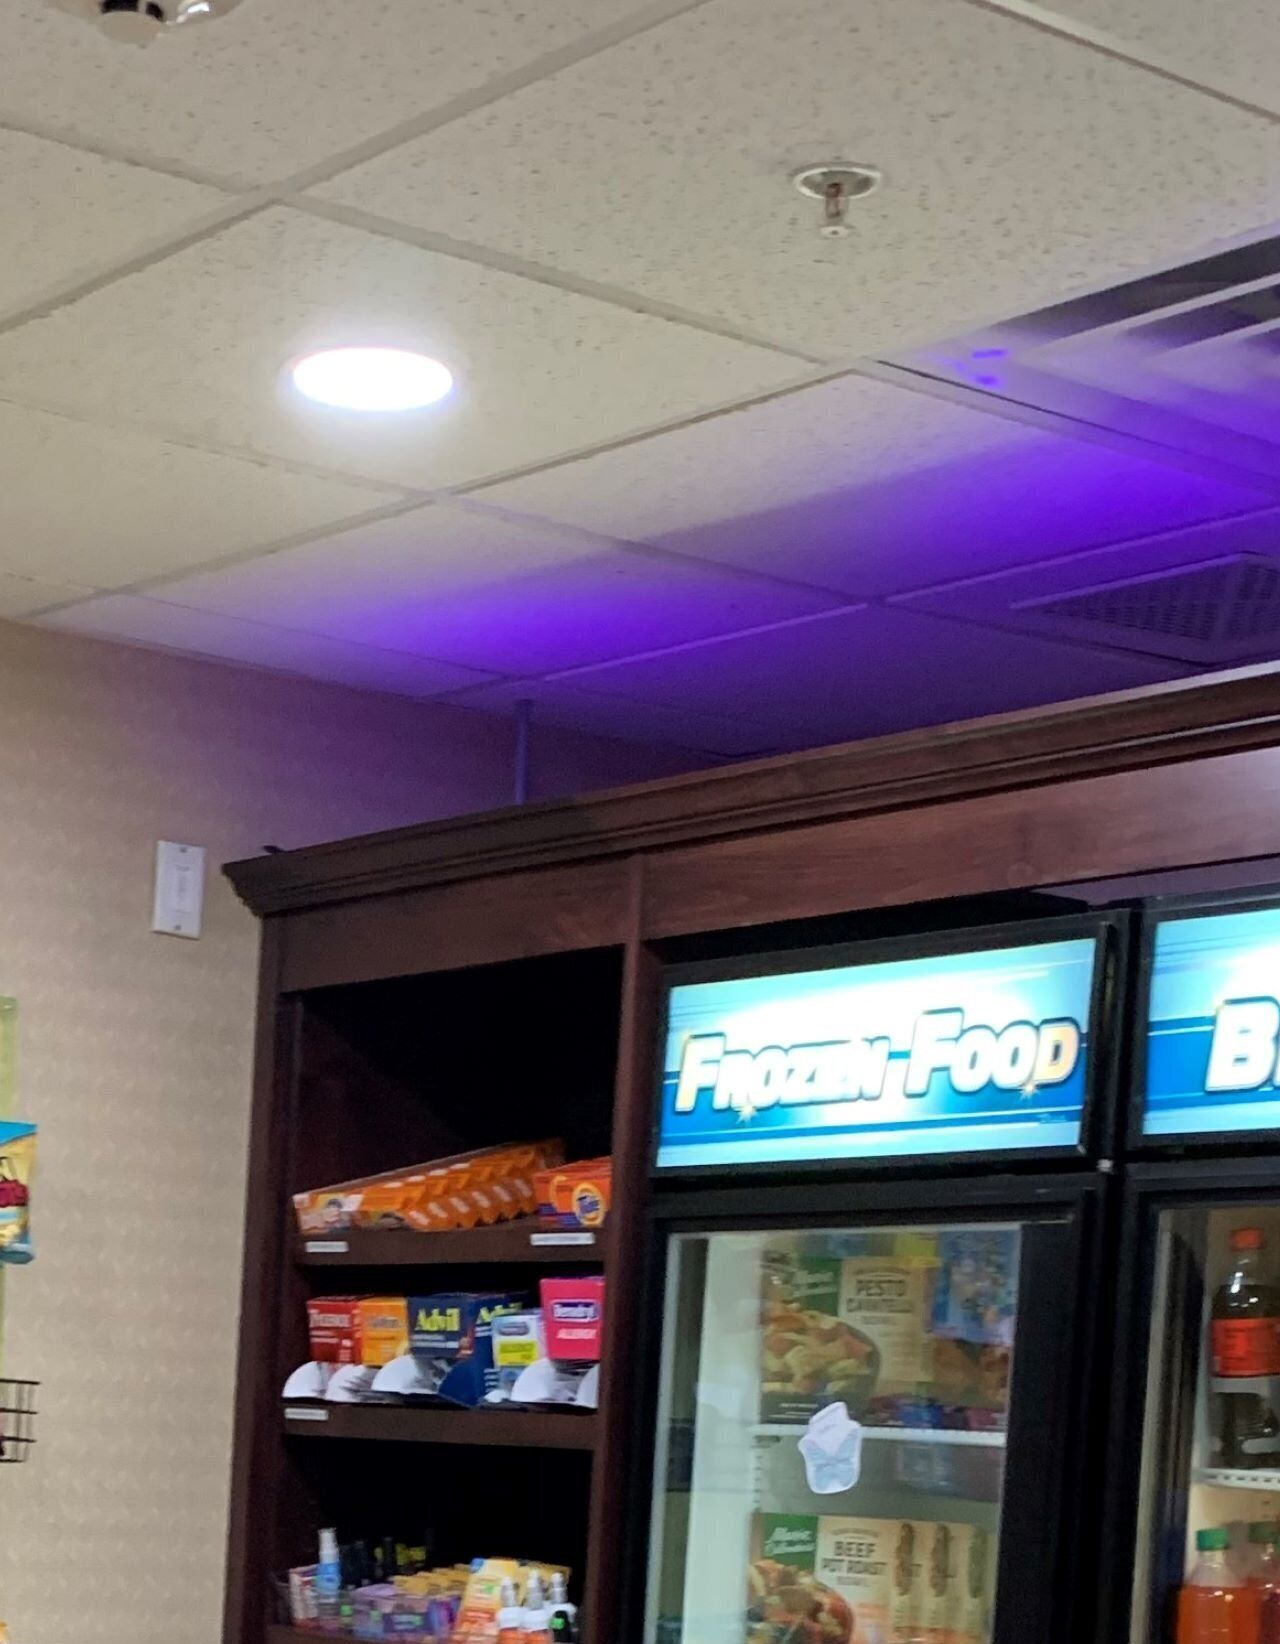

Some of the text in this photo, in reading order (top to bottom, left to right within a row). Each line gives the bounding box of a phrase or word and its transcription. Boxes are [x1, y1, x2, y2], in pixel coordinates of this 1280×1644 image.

[675, 1007, 1079, 1112] FROZEN FOOD
[415, 1307, 459, 1331] Advil
[834, 1541, 876, 1558] BEEF
